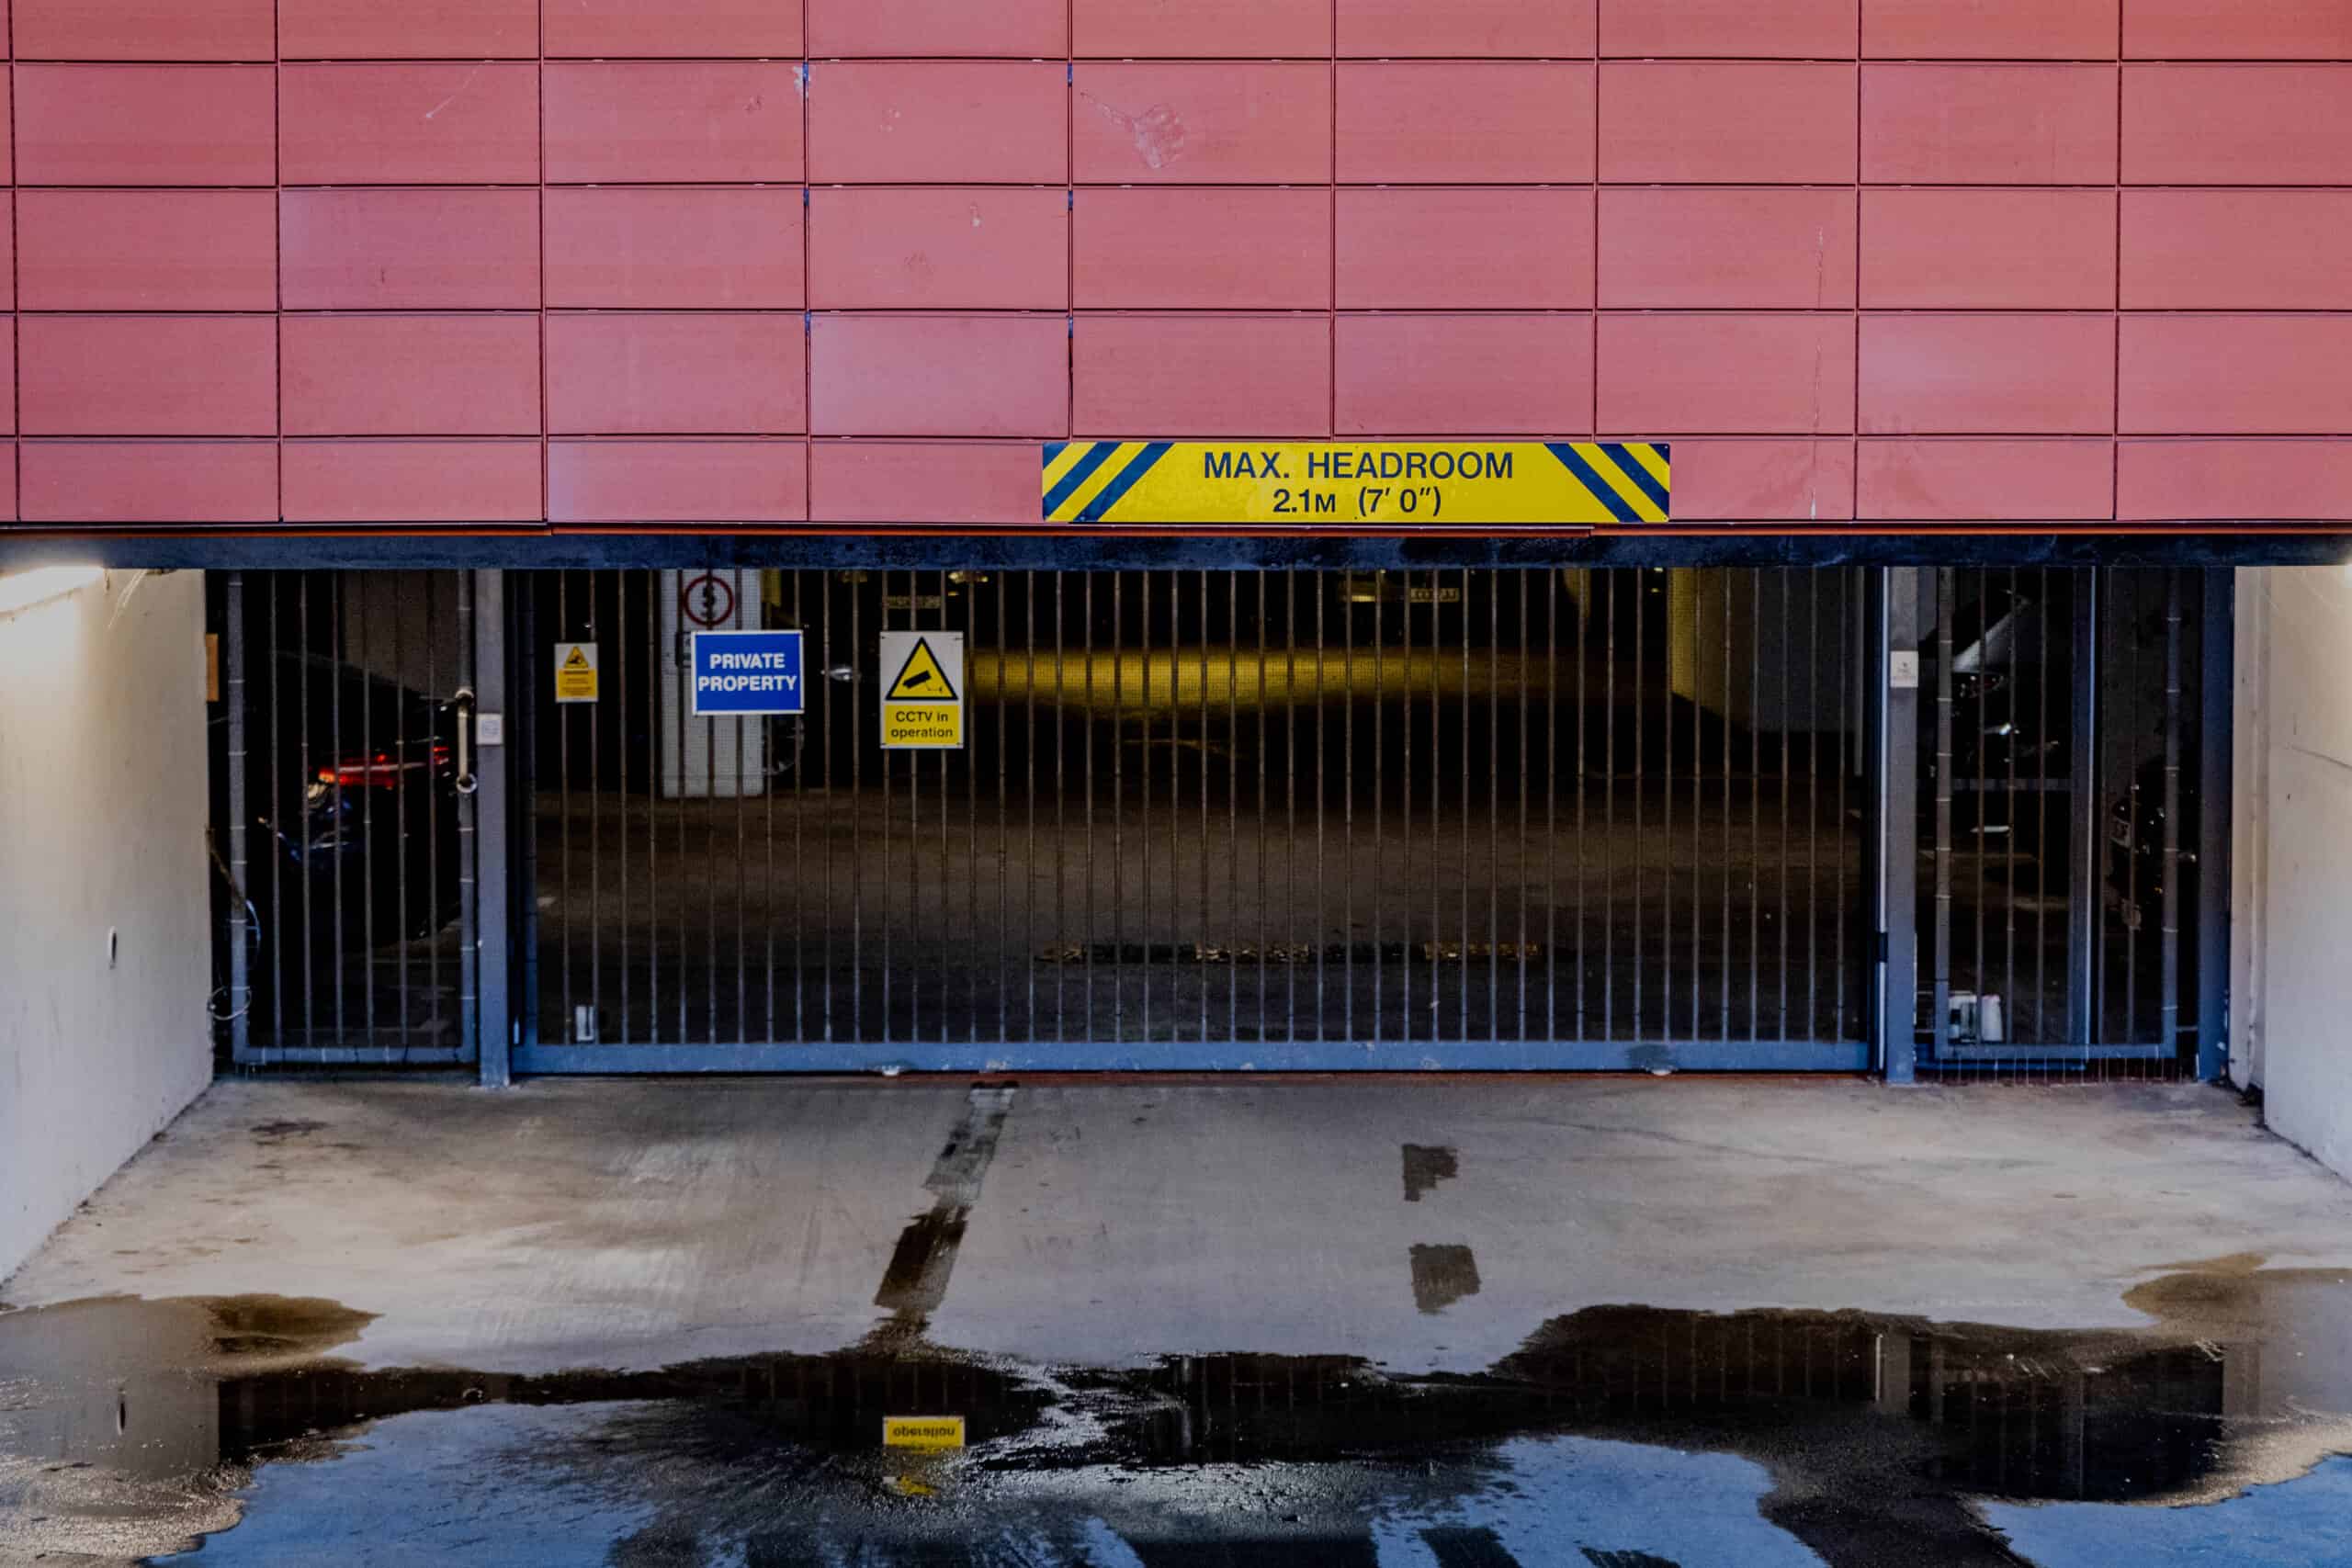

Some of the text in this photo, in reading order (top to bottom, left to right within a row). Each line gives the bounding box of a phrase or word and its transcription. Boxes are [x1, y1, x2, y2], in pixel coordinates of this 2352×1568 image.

[1204, 451, 1513, 479] MAX. HEADROOM
[709, 653, 786, 670] PRIVATE
[698, 675, 797, 692] PROPERTY
[896, 710, 949, 723] CCTV in
[890, 727, 954, 741] operation
